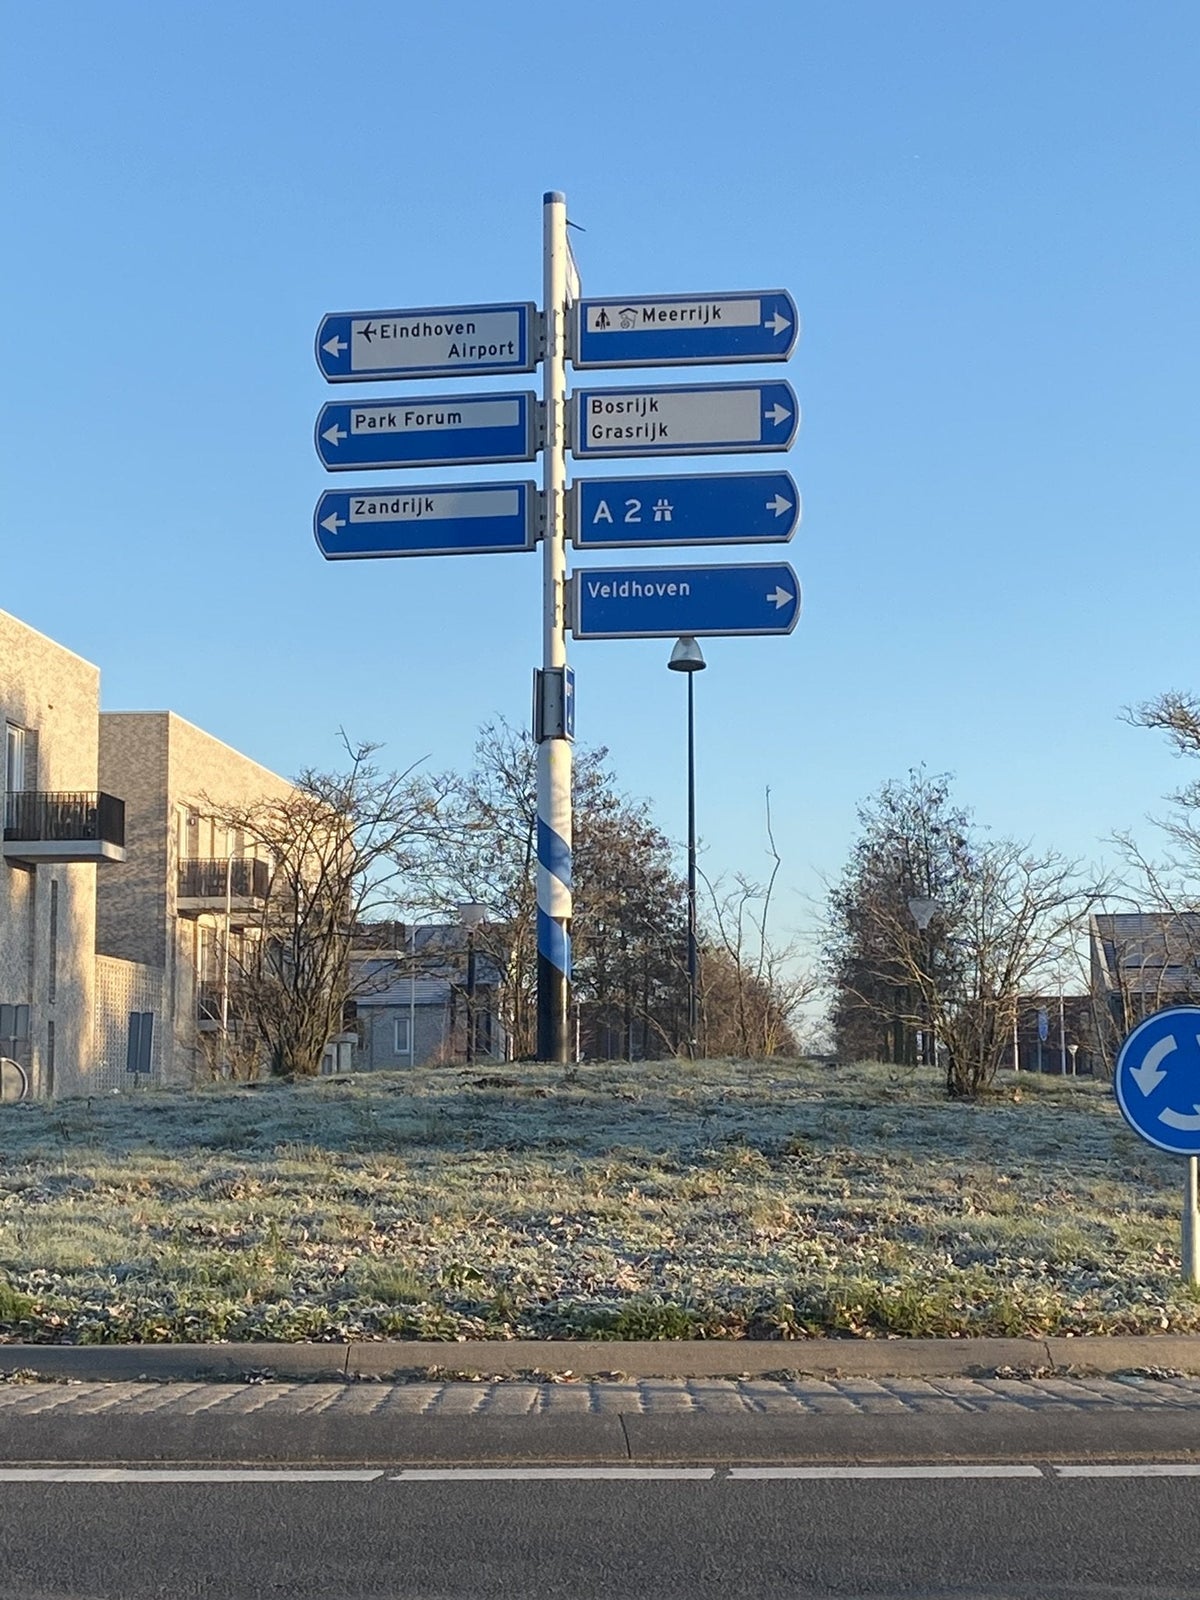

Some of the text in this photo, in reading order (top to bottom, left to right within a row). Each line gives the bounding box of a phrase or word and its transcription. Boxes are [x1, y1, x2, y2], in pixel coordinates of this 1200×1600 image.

[642, 305, 722, 325] Meerrijk
[381, 322, 476, 339] Eindhoven
[448, 341, 514, 359] Airport
[591, 398, 659, 416] Bosrijk
[355, 411, 462, 429] Park Forum
[591, 423, 669, 441] Grasrijk
[355, 497, 434, 517] Zandrijk
[593, 499, 642, 524] A 2
[587, 581, 691, 599] Veldhoven
